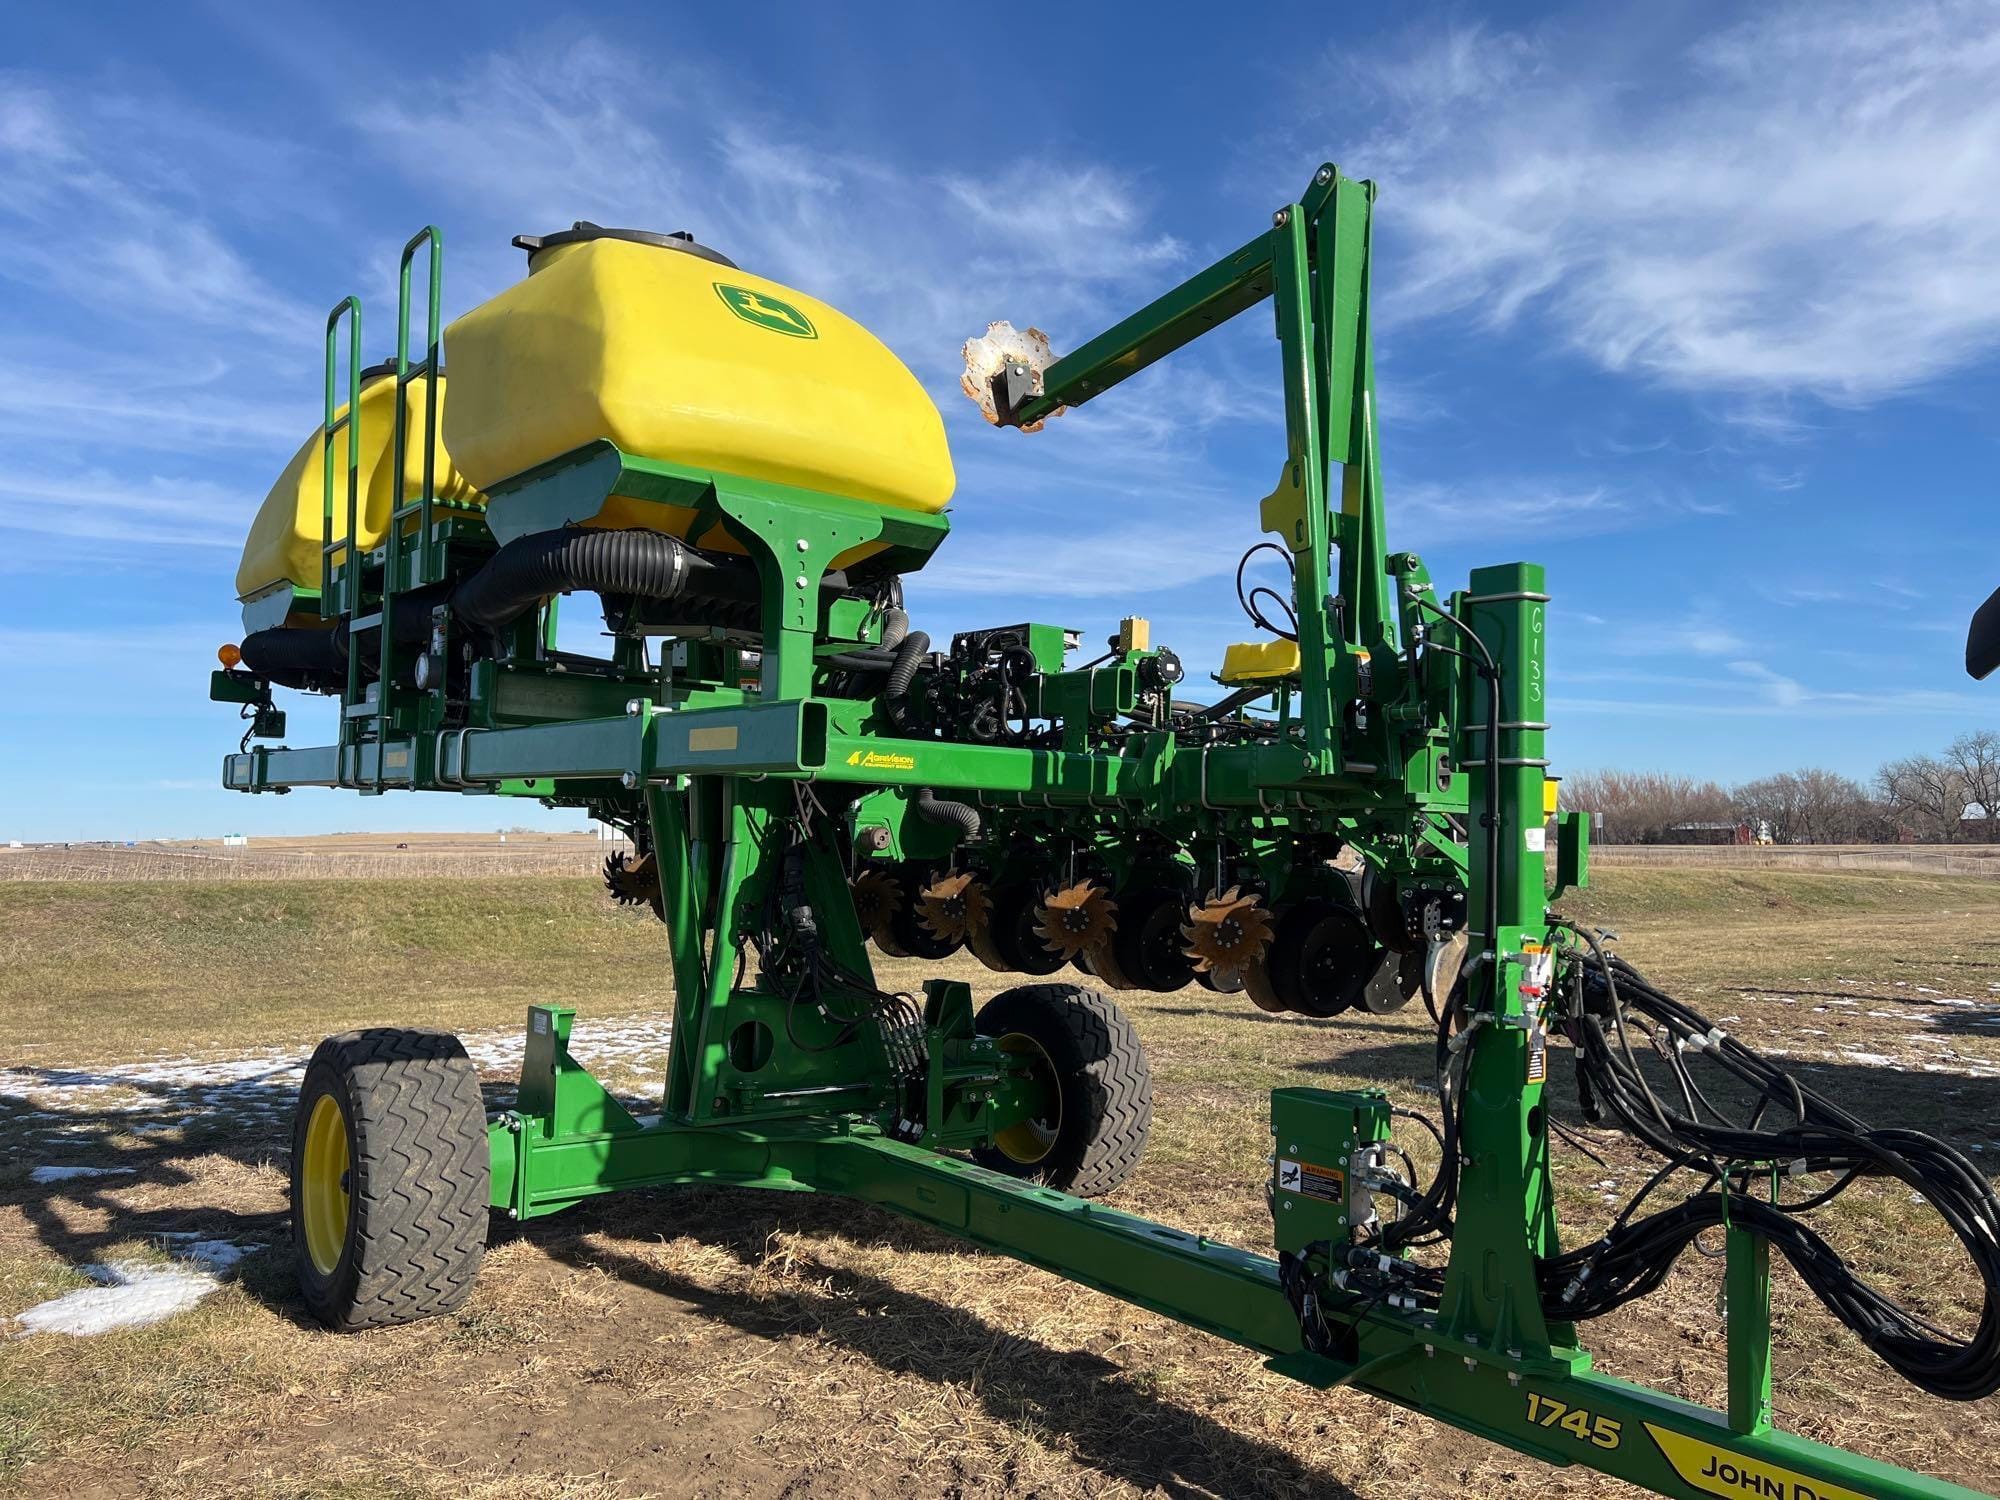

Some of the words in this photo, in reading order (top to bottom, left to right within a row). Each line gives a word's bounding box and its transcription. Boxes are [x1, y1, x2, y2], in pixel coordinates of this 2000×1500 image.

[1530, 607, 1542, 702] 6133
[1527, 1393, 1621, 1449] 1745
[1701, 1455, 1785, 1500] JOHN
